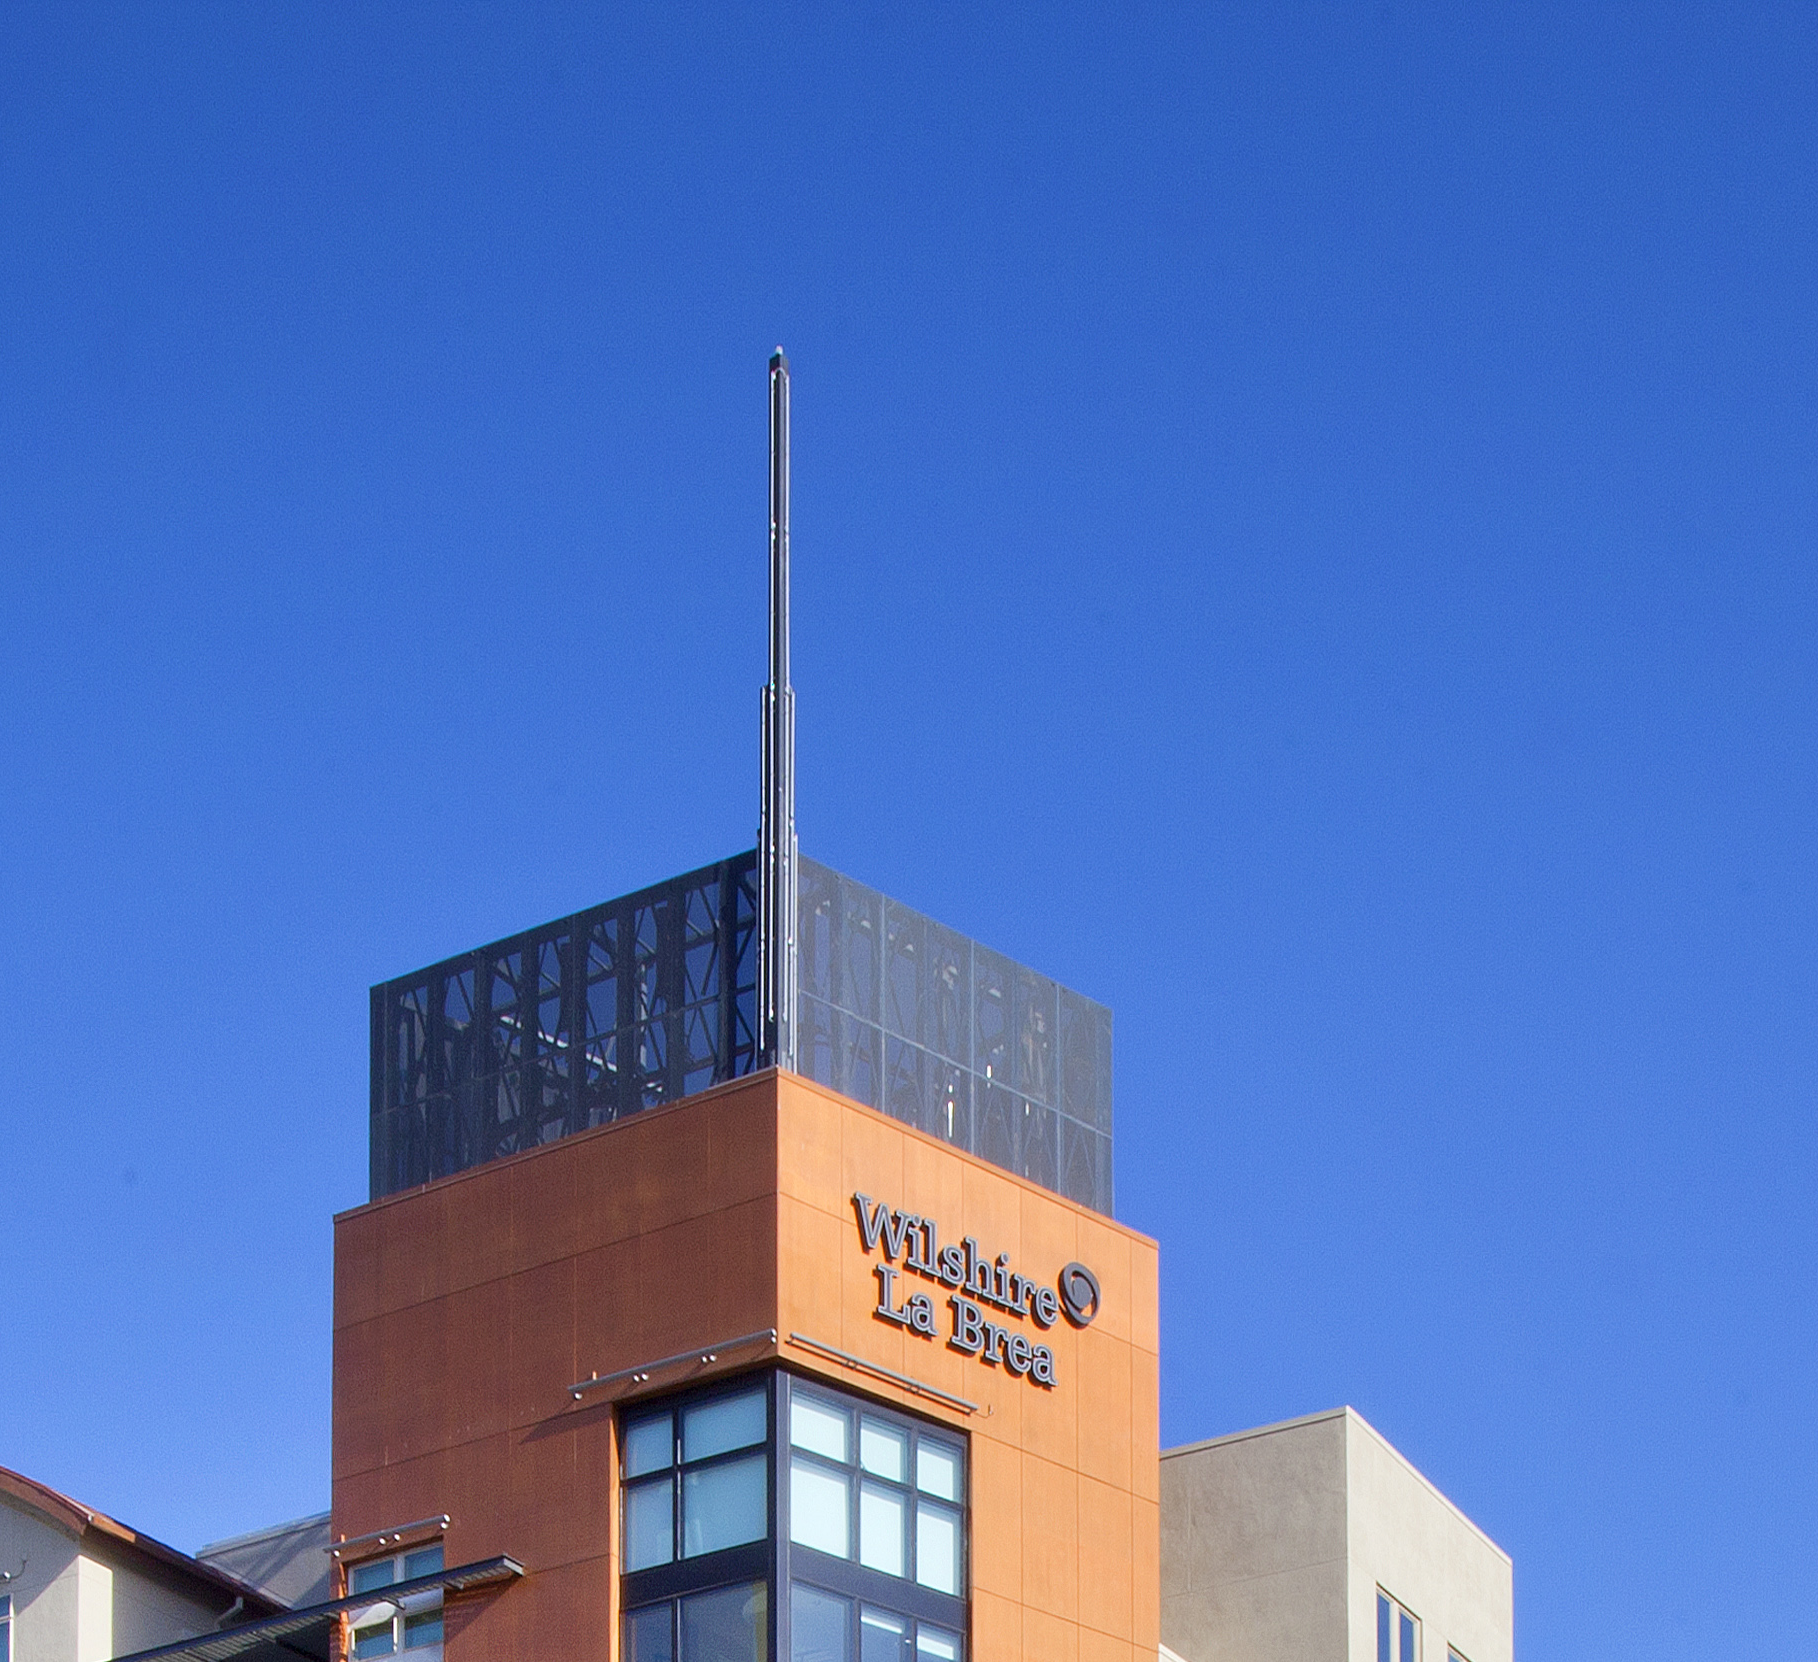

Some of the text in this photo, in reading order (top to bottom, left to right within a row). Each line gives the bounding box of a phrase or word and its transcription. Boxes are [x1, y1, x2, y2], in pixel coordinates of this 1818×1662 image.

[853, 1191, 1059, 1329] Wilshire
[876, 1263, 1058, 1388] La Brea
